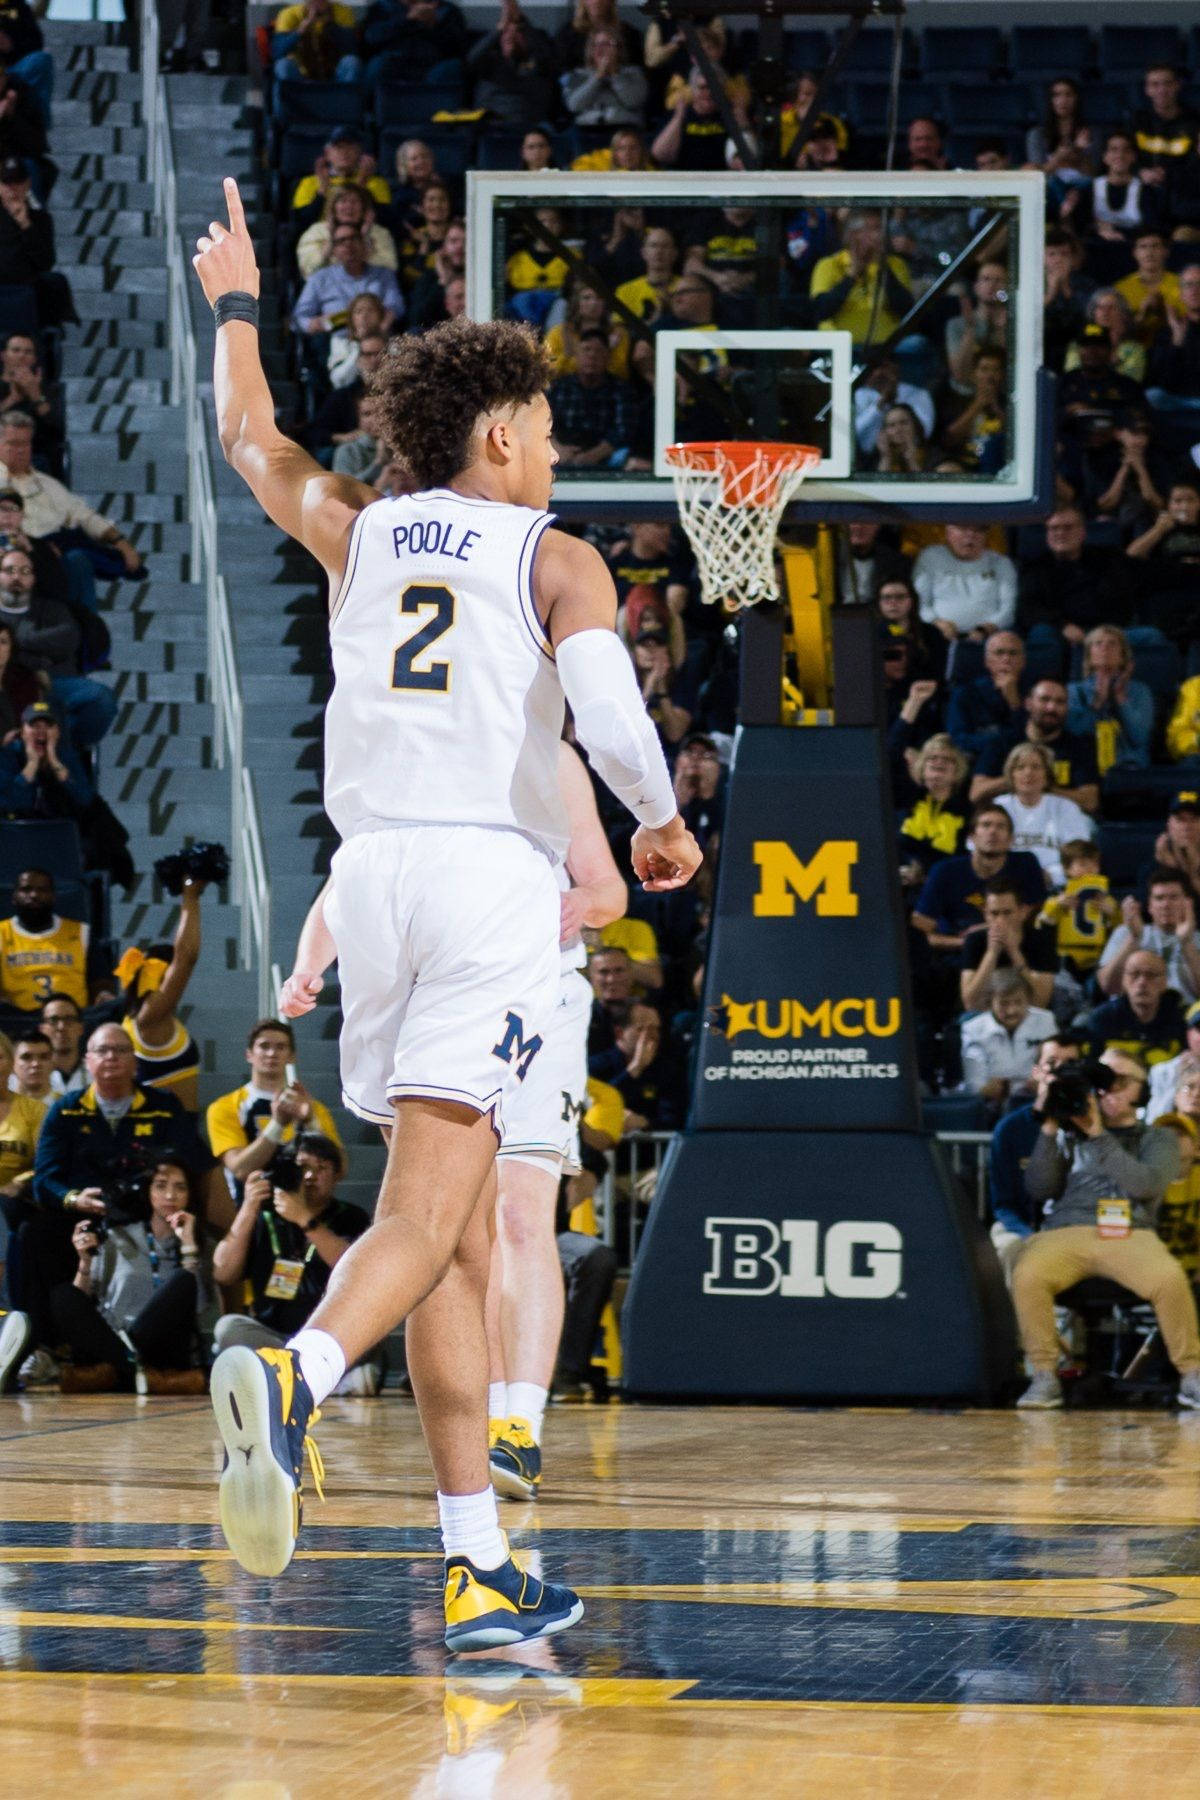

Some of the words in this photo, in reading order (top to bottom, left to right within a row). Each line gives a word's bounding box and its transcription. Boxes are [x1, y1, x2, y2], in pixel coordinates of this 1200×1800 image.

[392, 520, 482, 562] POOLE
[390, 581, 455, 694] 2
[753, 840, 859, 917] M
[7, 950, 74, 967] MICHIGAN
[33, 975, 53, 1002] 3
[756, 997, 901, 1039] UMCU
[491, 1008, 545, 1083] M
[731, 1048, 790, 1064] PROUD
[791, 1047, 868, 1062] PARTNER
[704, 1065, 729, 1081] OF
[730, 1064, 809, 1080] MICHIGAN
[811, 1062, 899, 1079] ATHLETICS
